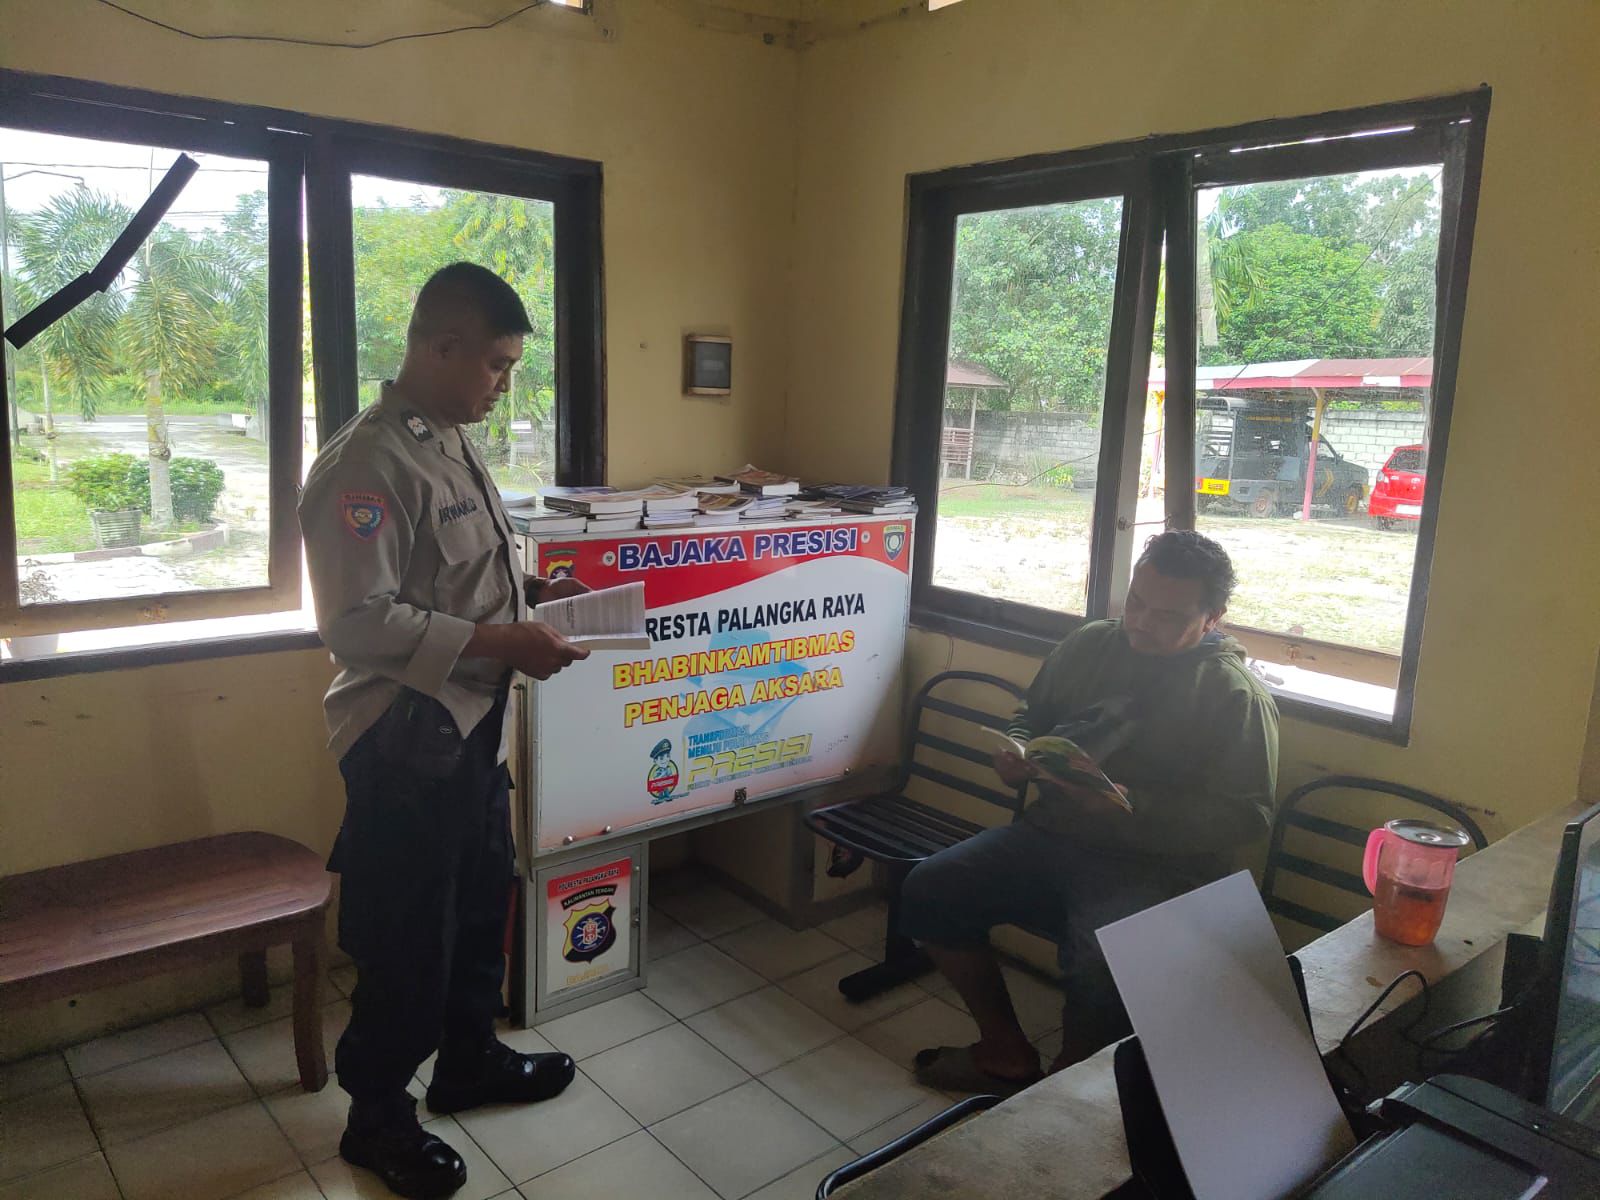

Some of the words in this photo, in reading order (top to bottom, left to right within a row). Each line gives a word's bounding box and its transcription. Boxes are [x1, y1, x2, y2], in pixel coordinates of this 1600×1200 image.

[617, 537, 747, 571] BAJAKA
[754, 528, 858, 560] PRESISI
[717, 598, 817, 633] PALANGKA
[822, 592, 866, 618] RAYA
[613, 630, 856, 689] BHABINKAMTIBMAS
[624, 684, 746, 728] PENJAGA
[750, 666, 844, 704] AKSARA
[687, 733, 813, 783] PRESISI
[563, 889, 595, 907] KALIMANTAN
